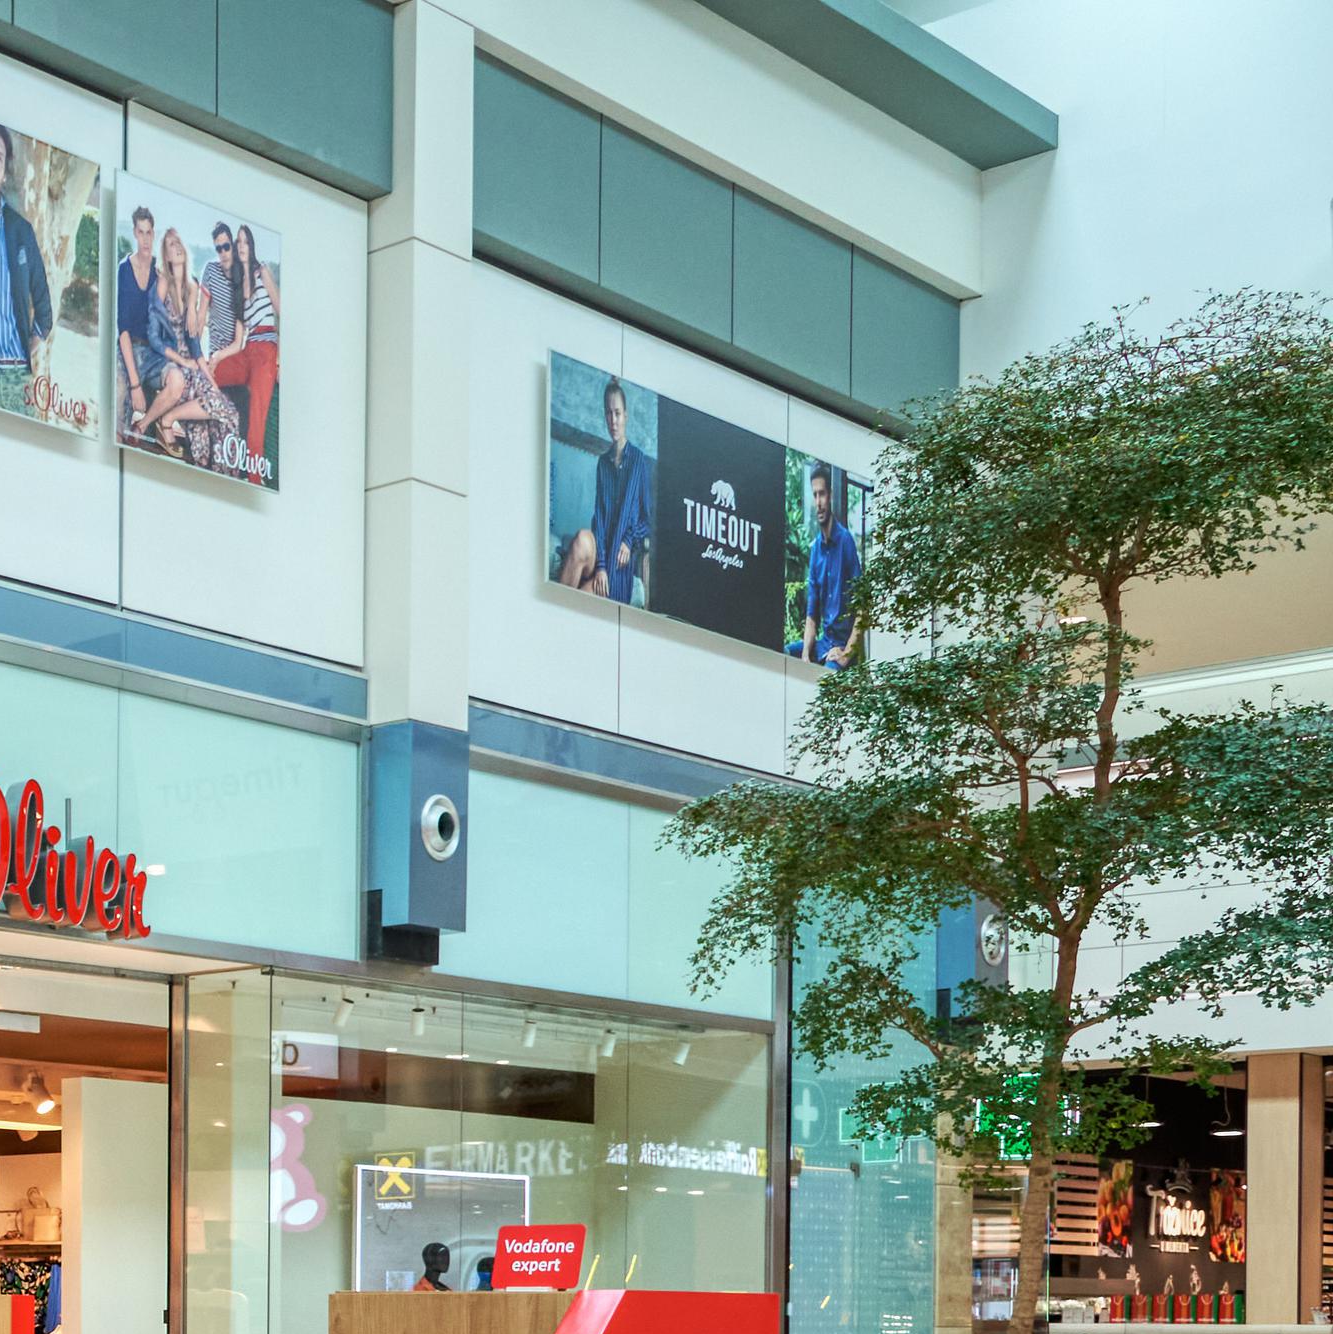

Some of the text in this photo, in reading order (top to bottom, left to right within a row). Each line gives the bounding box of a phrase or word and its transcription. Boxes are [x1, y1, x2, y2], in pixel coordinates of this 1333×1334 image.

[23, 375, 89, 426] s.Oliver
[213, 432, 274, 480] s.Oliver
[683, 498, 762, 556] TIMEOUT
[504, 1238, 575, 1255] Vodafone
[511, 1256, 561, 1275] expert
